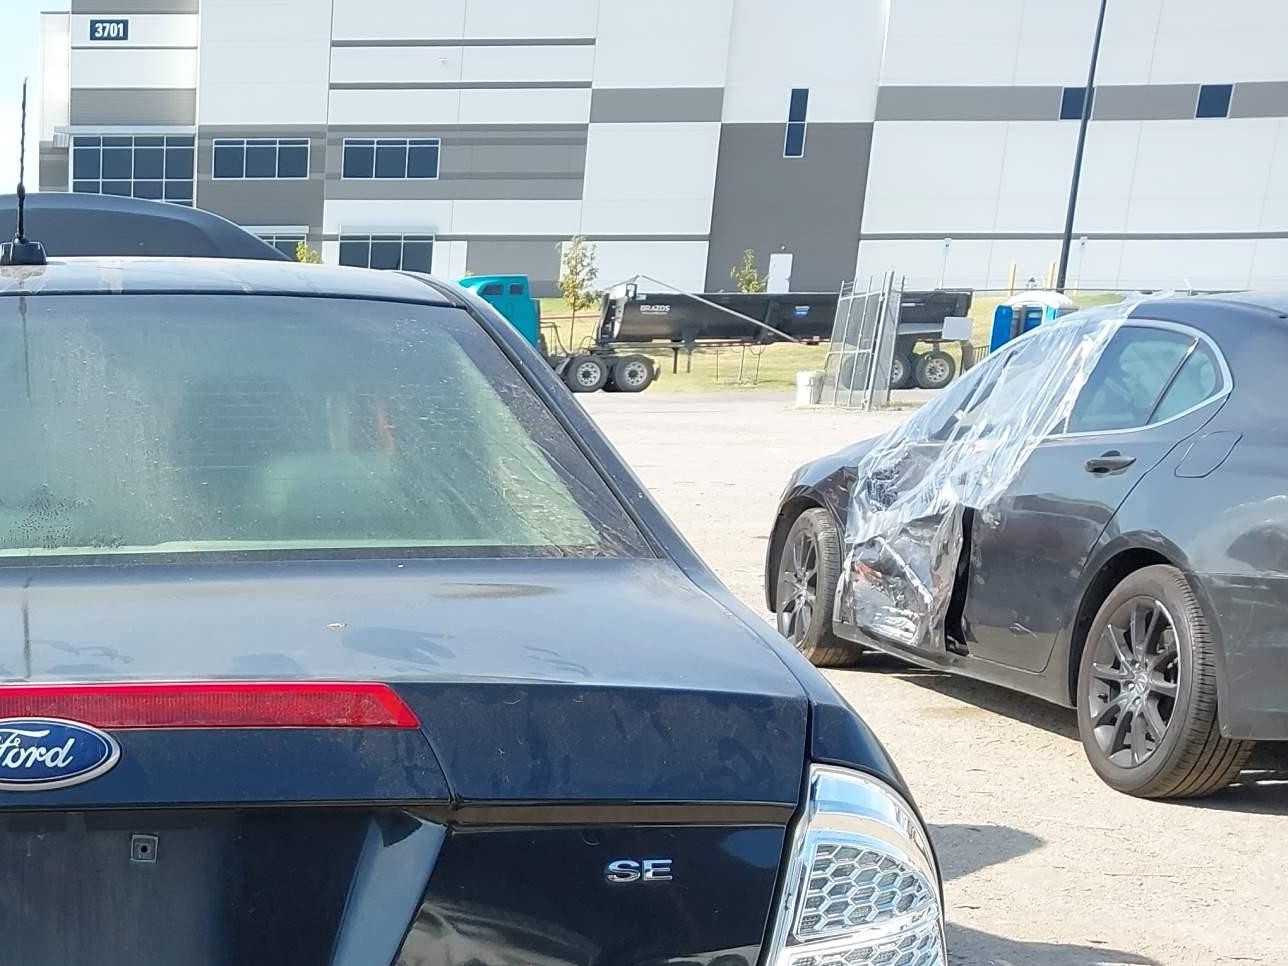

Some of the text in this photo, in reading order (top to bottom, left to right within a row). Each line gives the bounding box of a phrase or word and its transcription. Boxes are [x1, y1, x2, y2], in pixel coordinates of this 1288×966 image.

[94, 22, 124, 38] 3701
[639, 304, 671, 312] BRAZOS
[607, 859, 673, 882] SE
